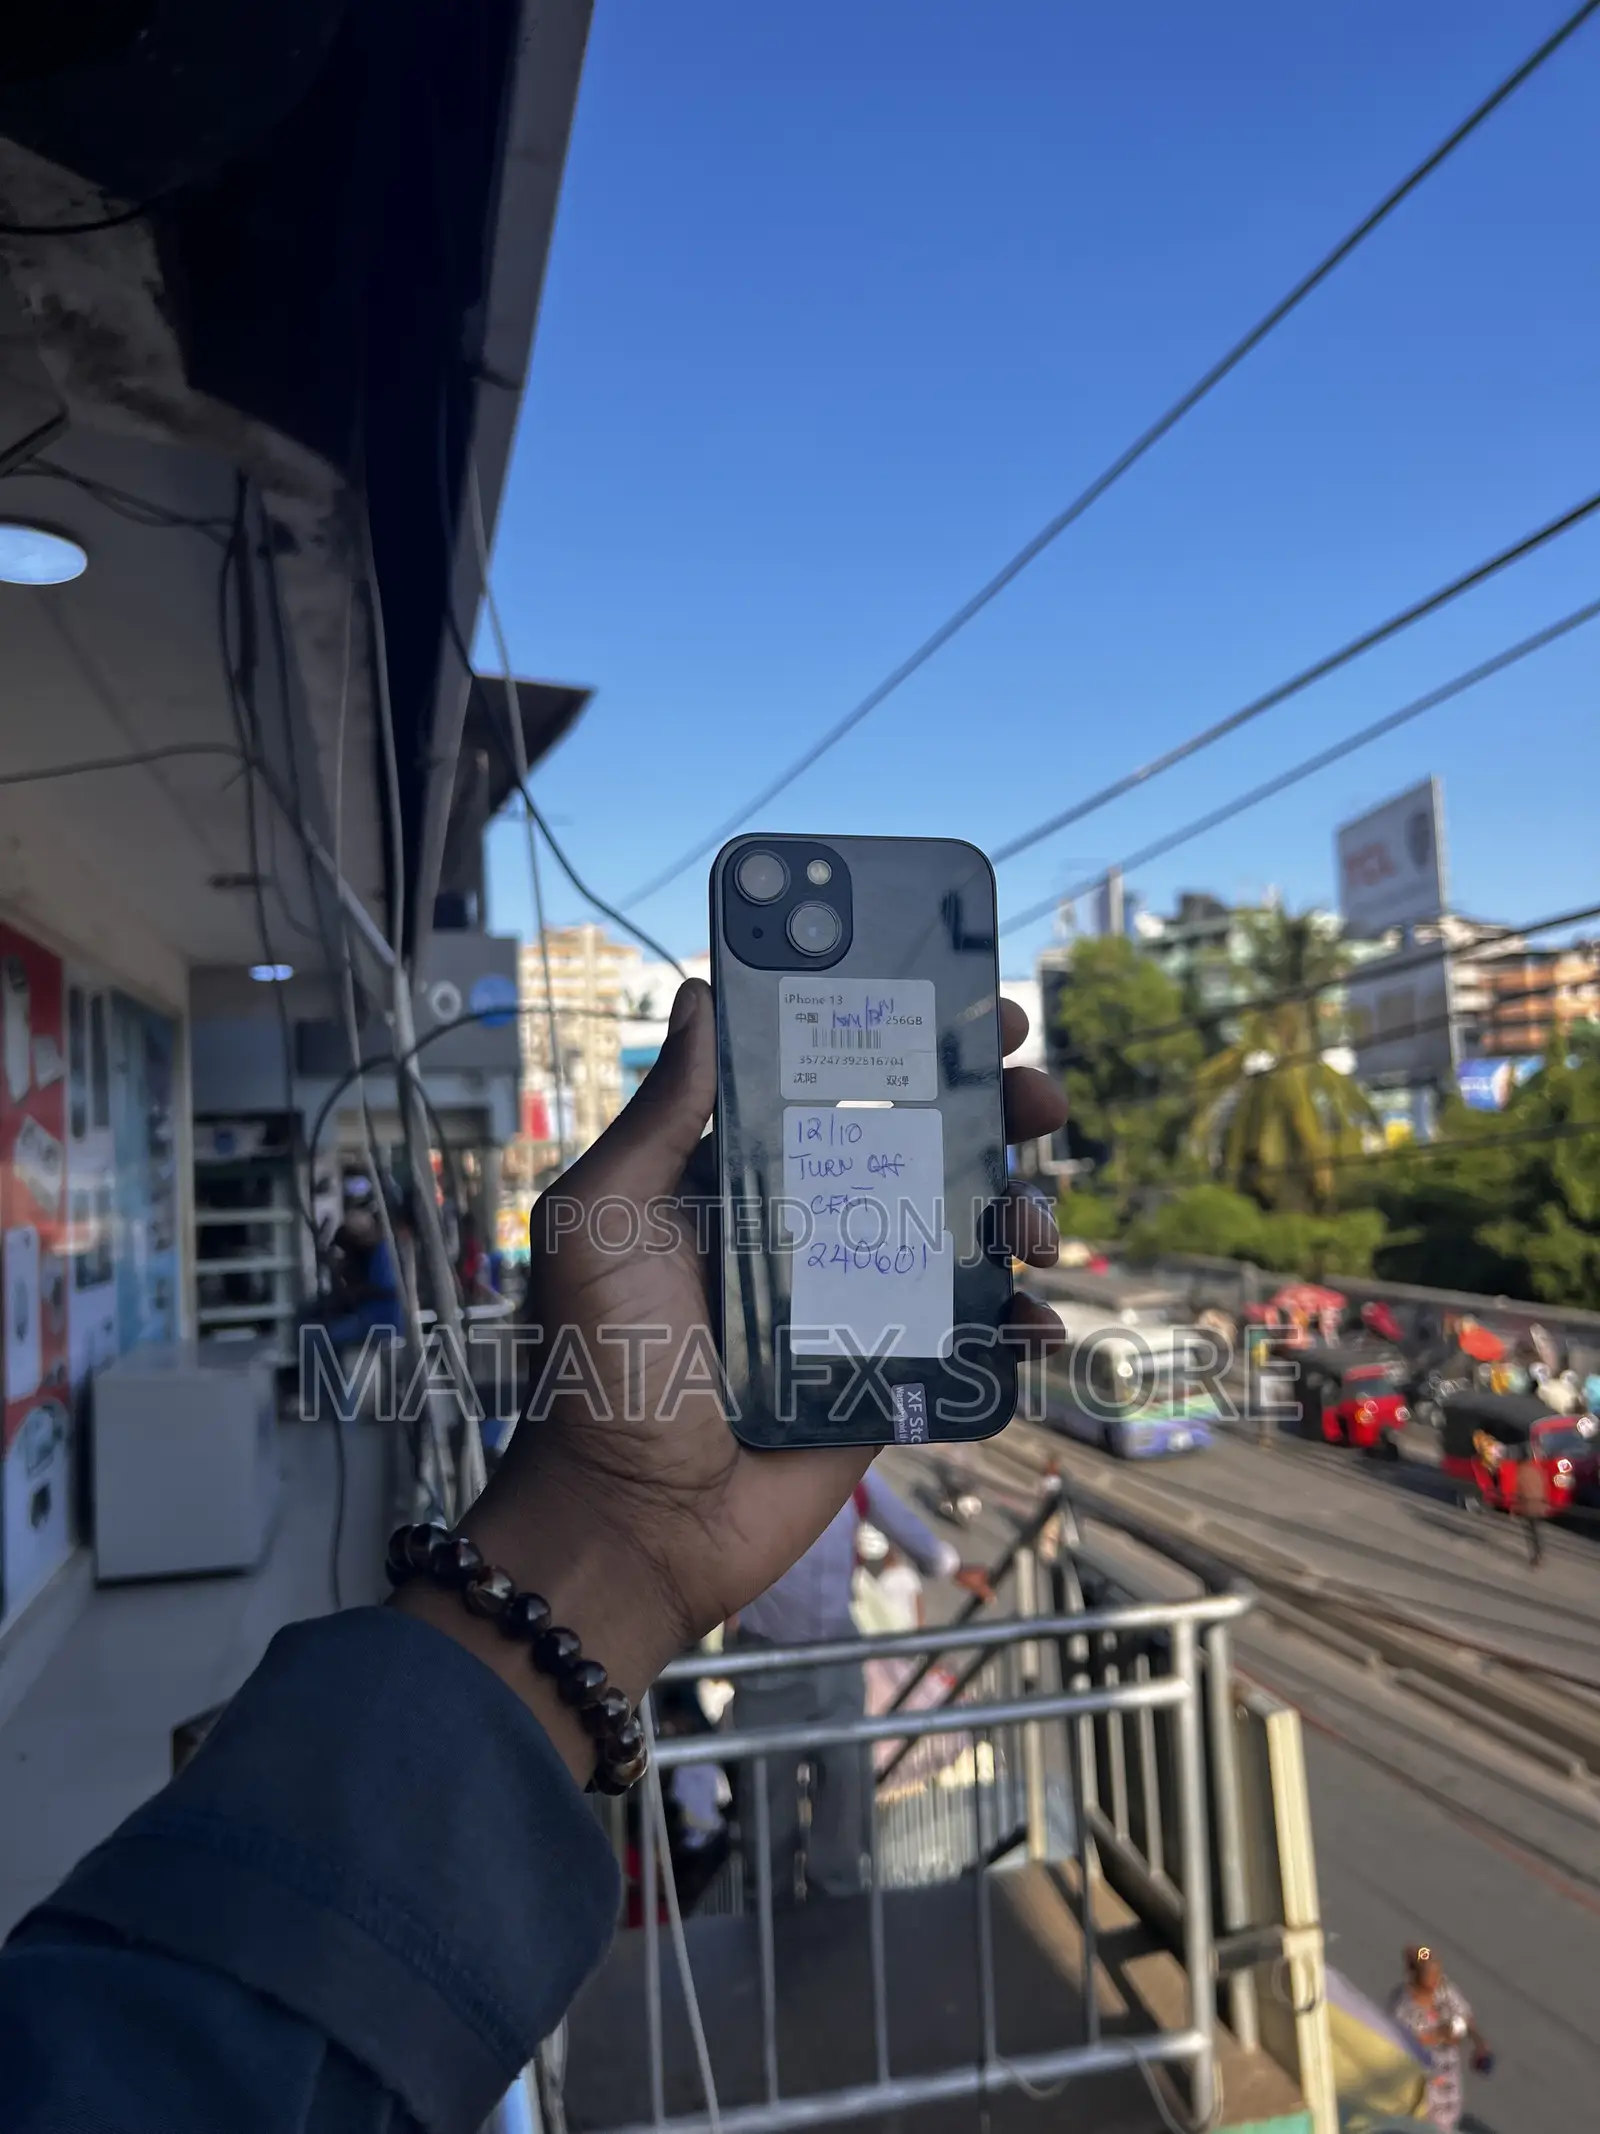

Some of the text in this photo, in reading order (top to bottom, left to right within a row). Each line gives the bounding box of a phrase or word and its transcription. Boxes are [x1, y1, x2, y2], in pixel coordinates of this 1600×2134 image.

[784, 993, 843, 1005] iPhone 13
[795, 1012, 819, 1024] 中国
[885, 1015, 923, 1026] 256GB
[798, 1114, 863, 1146] 12/10
[807, 1240, 927, 1274] 240601
[907, 1390, 923, 1413] XF
